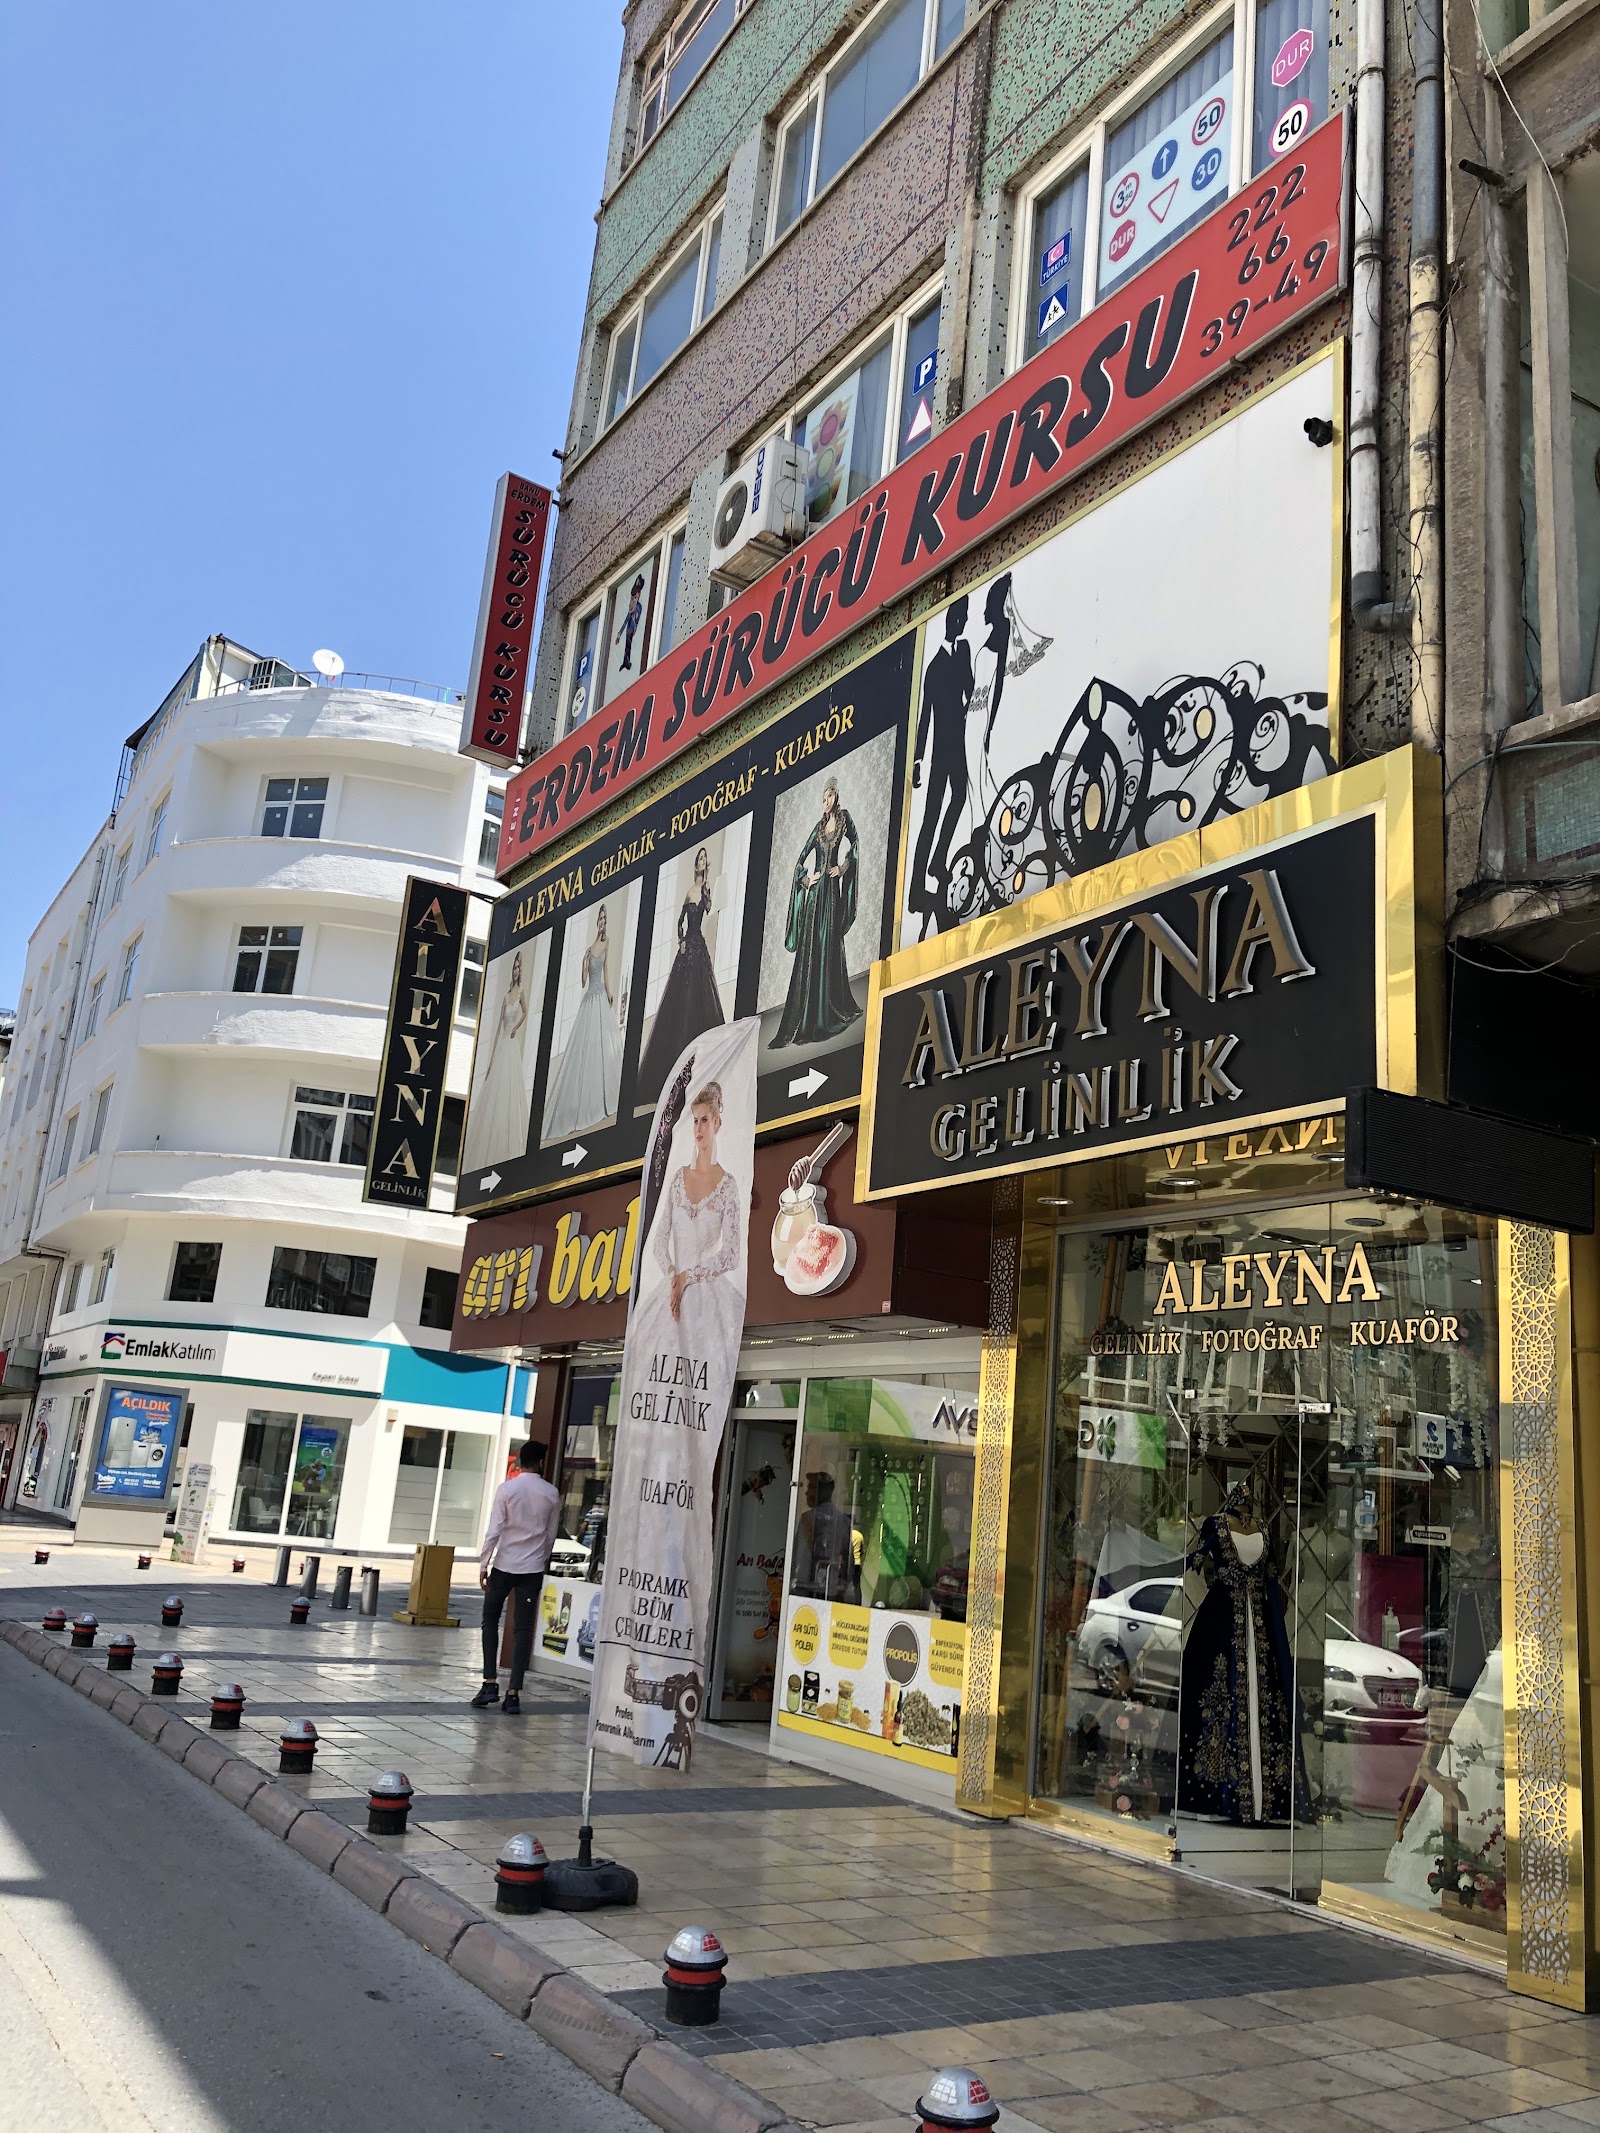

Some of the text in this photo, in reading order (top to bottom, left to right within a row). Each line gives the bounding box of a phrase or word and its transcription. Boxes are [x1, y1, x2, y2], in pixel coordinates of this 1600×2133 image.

[1276, 39, 1309, 77] DUR
[1197, 105, 1220, 137] 50
[1278, 110, 1302, 146] 50
[1196, 153, 1219, 186] 30
[1227, 163, 1306, 253] 222
[1110, 225, 1135, 256] DUR
[1238, 221, 1290, 285] 66
[1200, 239, 1330, 358] 39-49
[919, 358, 932, 387] P
[752, 447, 766, 515] BEKO
[511, 490, 547, 511] ERDEM
[519, 269, 1199, 843] ERDEM SÜRÜCÜ KURSU
[485, 509, 537, 747] SÜRÜCÜ KURSU
[580, 656, 588, 677] P
[512, 866, 584, 933] ALEYNA
[591, 829, 656, 887] GELİNLİK
[670, 766, 757, 840] FOTOĞRAF
[773, 704, 855, 776] KUAFÖR
[900, 868, 1316, 1090] ALEYNA
[381, 896, 451, 1180] ALEYNA
[929, 1027, 1243, 1162] GELİNLİK
[372, 1179, 427, 1199] GELİNLİK
[462, 1195, 641, 1320] arı bal
[1152, 1241, 1381, 1316] ALEYNA
[125, 1339, 217, 1361] EmlakKatılım
[1090, 1309, 1459, 1356] GELİNLİK FOTOĞRAF KUAFÖR
[121, 1397, 172, 1411] AÇILDIK
[794, 1639, 814, 1651] POLEN
[886, 1647, 918, 1664] PROPOLİS
[615, 1705, 634, 1721] Profes
